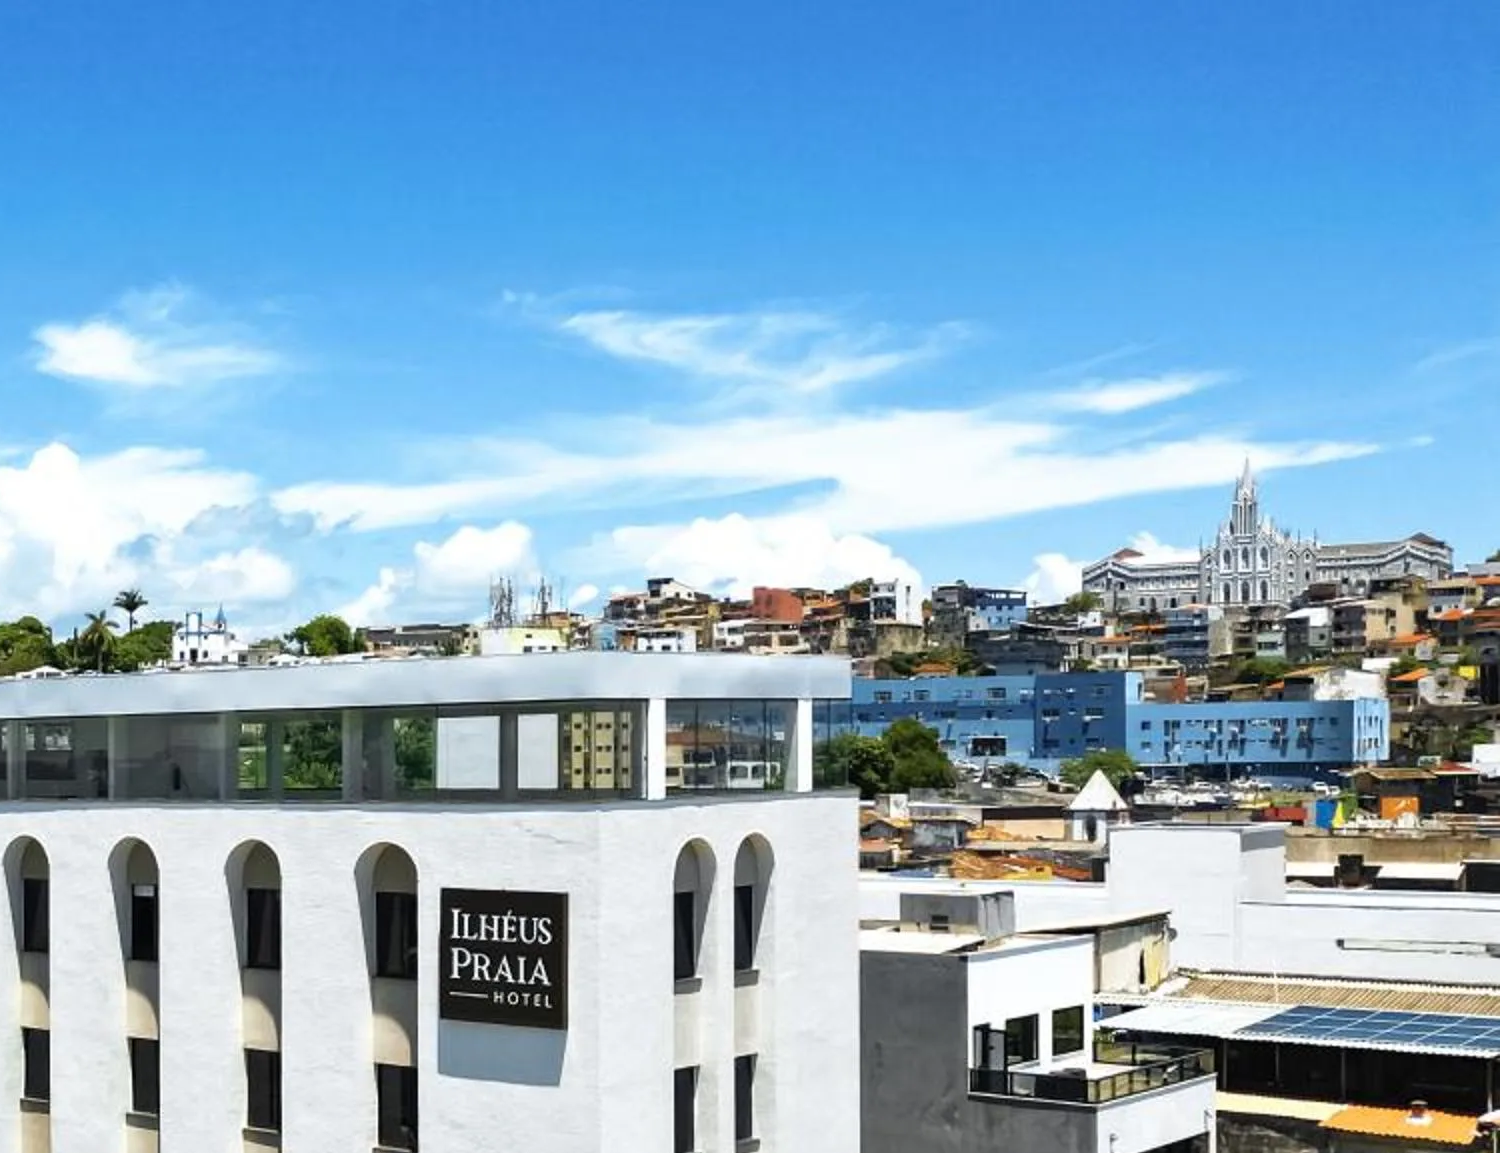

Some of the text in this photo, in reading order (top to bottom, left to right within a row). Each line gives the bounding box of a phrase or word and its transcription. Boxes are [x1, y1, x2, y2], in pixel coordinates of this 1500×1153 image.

[450, 907, 553, 945] ILHÉUS
[449, 946, 552, 987] PRAIA
[493, 990, 553, 1009] HOTEL
